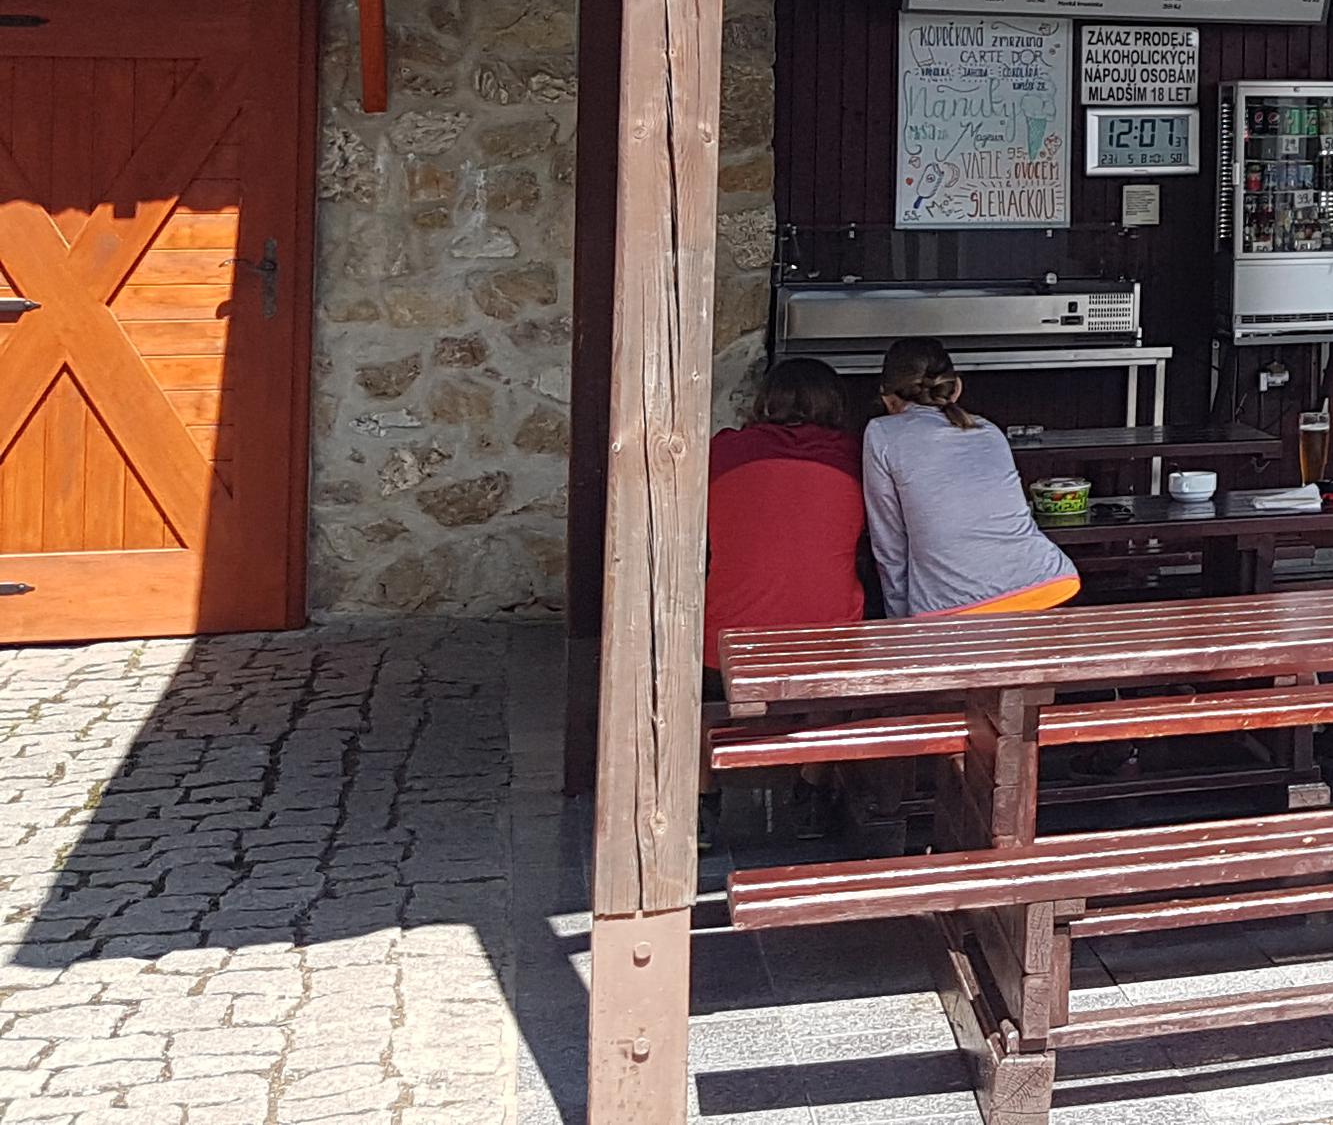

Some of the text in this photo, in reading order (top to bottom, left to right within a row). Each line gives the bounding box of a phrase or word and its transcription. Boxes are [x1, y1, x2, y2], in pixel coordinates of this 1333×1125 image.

[1087, 27, 1193, 47] ZÁKAZ PRODEJE
[960, 51, 1002, 64] CARTE
[1085, 46, 1195, 65] ALKOHOLICKÝCH
[1084, 64, 1196, 83] NÁPOJŮ OSOBÁM
[1088, 83, 1192, 102] MLADŠÍM 18 LET
[1108, 118, 1175, 148] 12:07
[960, 151, 1002, 180] VAFLE
[1014, 161, 1060, 181] OVOCEM
